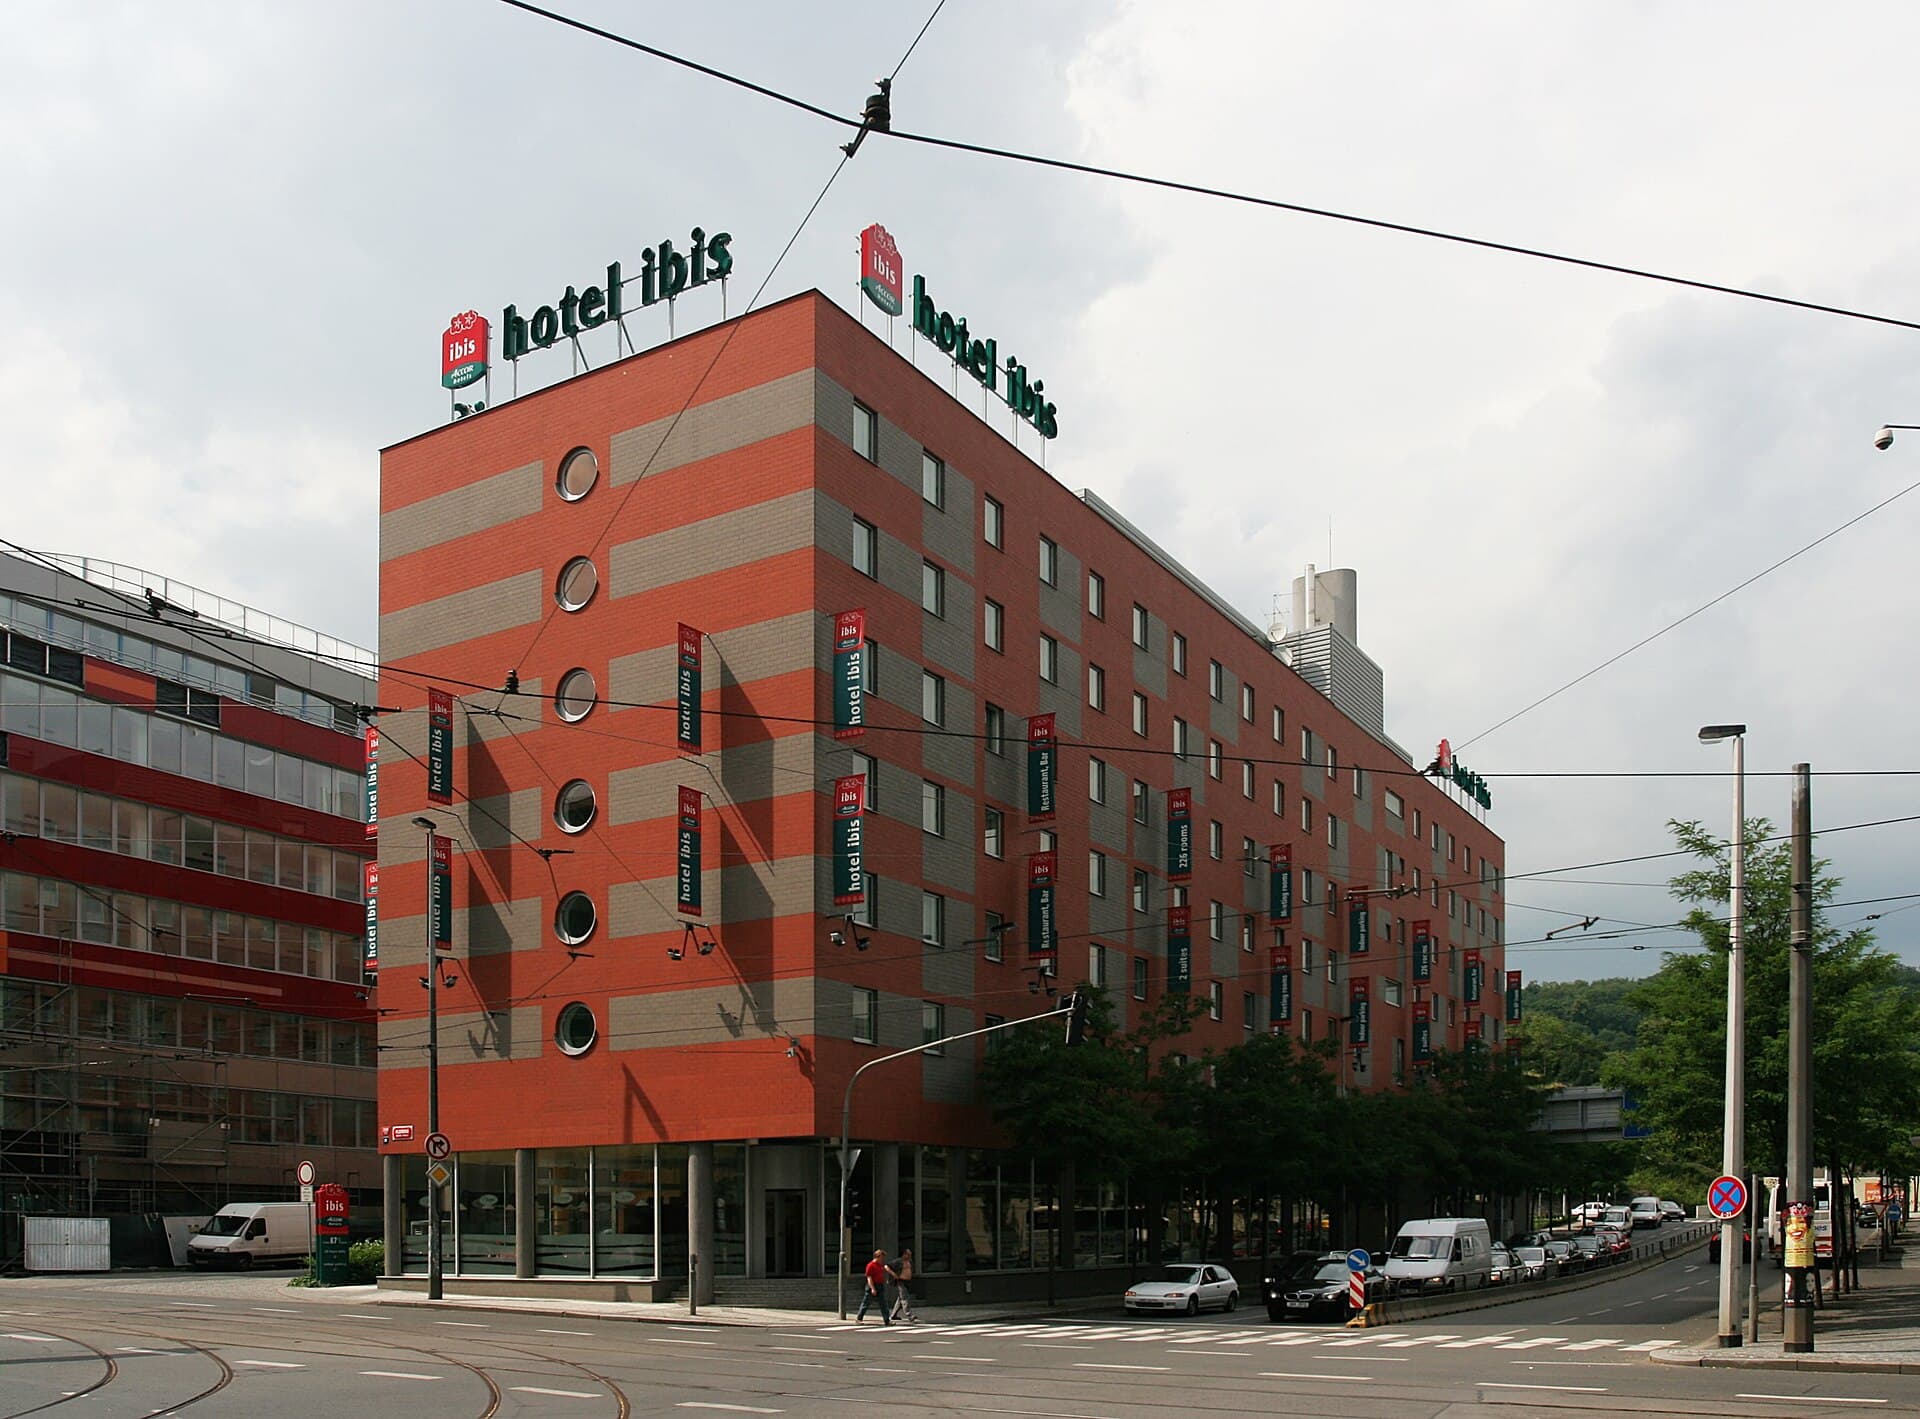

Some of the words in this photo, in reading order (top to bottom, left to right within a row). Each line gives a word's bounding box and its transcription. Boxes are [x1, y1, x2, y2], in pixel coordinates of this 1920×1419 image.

[873, 251, 896, 285] ibis
[503, 262, 621, 361] hotel
[641, 226, 733, 306] ibis
[449, 338, 476, 362] ibis
[914, 275, 997, 390] hotel
[1007, 356, 1058, 440] ibis
[841, 625, 857, 637] ibis
[683, 640, 696, 654] ibis
[847, 652, 860, 681] ibis
[680, 670, 691, 697] ibis
[847, 685, 860, 725] hotel
[680, 701, 691, 740] hotel
[1034, 727, 1048, 737] ibis
[431, 729, 443, 753] ibis
[1039, 752, 1049, 766] Bar
[367, 763, 377, 786] ibis
[431, 757, 442, 791] hotel
[368, 790, 377, 824] hotel
[683, 802, 696, 815] ibis
[841, 791, 857, 803] ibis
[1173, 800, 1185, 808] ibis
[680, 832, 691, 859] ibis
[847, 819, 860, 848] ibis
[1180, 824, 1188, 851] rooms
[847, 851, 861, 892] hotel
[1035, 865, 1049, 874] ibis
[1179, 852, 1188, 869] 226
[680, 863, 691, 902] hotel
[367, 898, 377, 921] ibis
[367, 926, 377, 959] hotel
[326, 1200, 344, 1211] ibis
